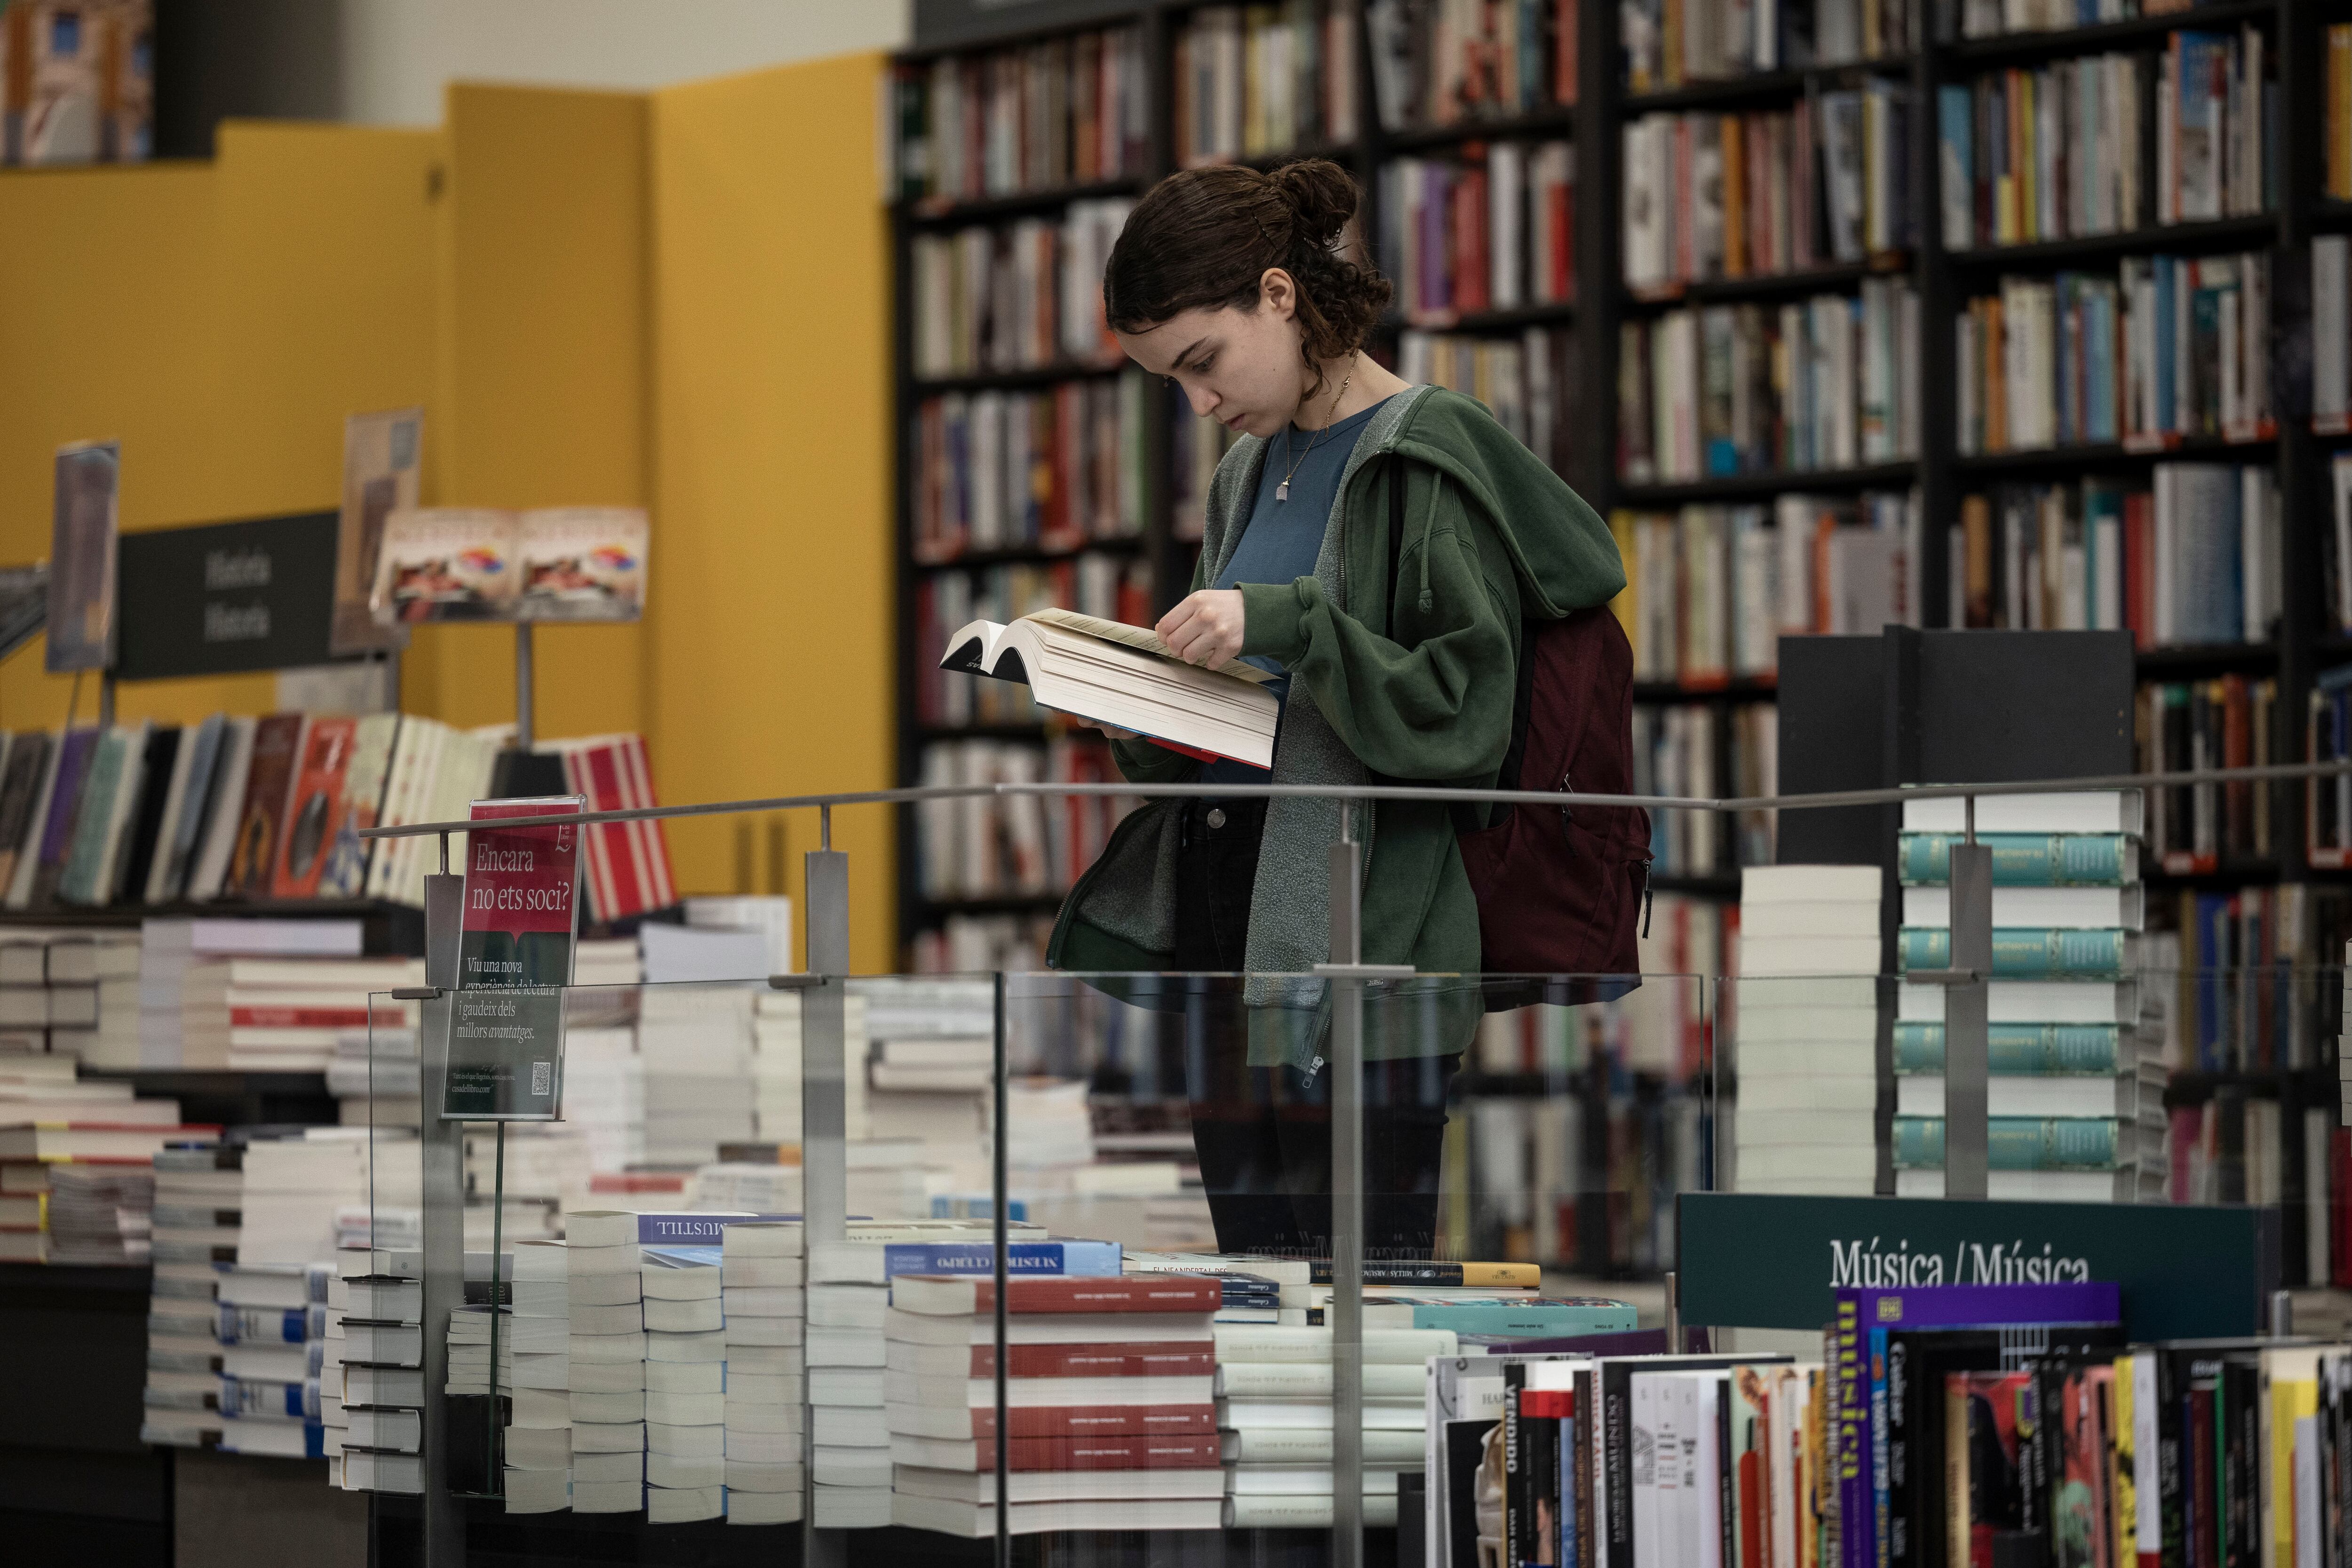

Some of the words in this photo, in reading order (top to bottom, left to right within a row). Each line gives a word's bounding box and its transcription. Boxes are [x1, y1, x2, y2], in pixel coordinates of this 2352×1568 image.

[476, 843, 533, 872] Encara
[472, 889, 494, 910] no
[498, 887, 523, 910] ets
[526, 881, 569, 911] soci?
[468, 957, 481, 972] Viu
[484, 961, 499, 972] una
[501, 961, 522, 972] nova
[461, 979, 515, 998] experiència
[511, 979, 527, 995] de
[524, 979, 560, 995] lectura
[459, 1000, 462, 1016] i
[462, 1000, 496, 1020] gaudeix
[498, 1001, 515, 1016] dels
[457, 1023, 487, 1038] millors
[489, 1025, 534, 1043] avantatges.
[452, 1084, 490, 1093] casadellibro.com
[657, 1222, 727, 1235] MUSTILL
[937, 1257, 990, 1269] CUERPO
[1008, 1257, 1059, 1269] NUESTR
[1829, 1236, 1943, 1288] Música
[1955, 1240, 1965, 1287] /
[1970, 1239, 2089, 1285] Música
[1838, 1300, 1867, 1480] música
[1505, 1384, 1518, 1473] VENDIDO
[1606, 1394, 1620, 1472] MUNDO
